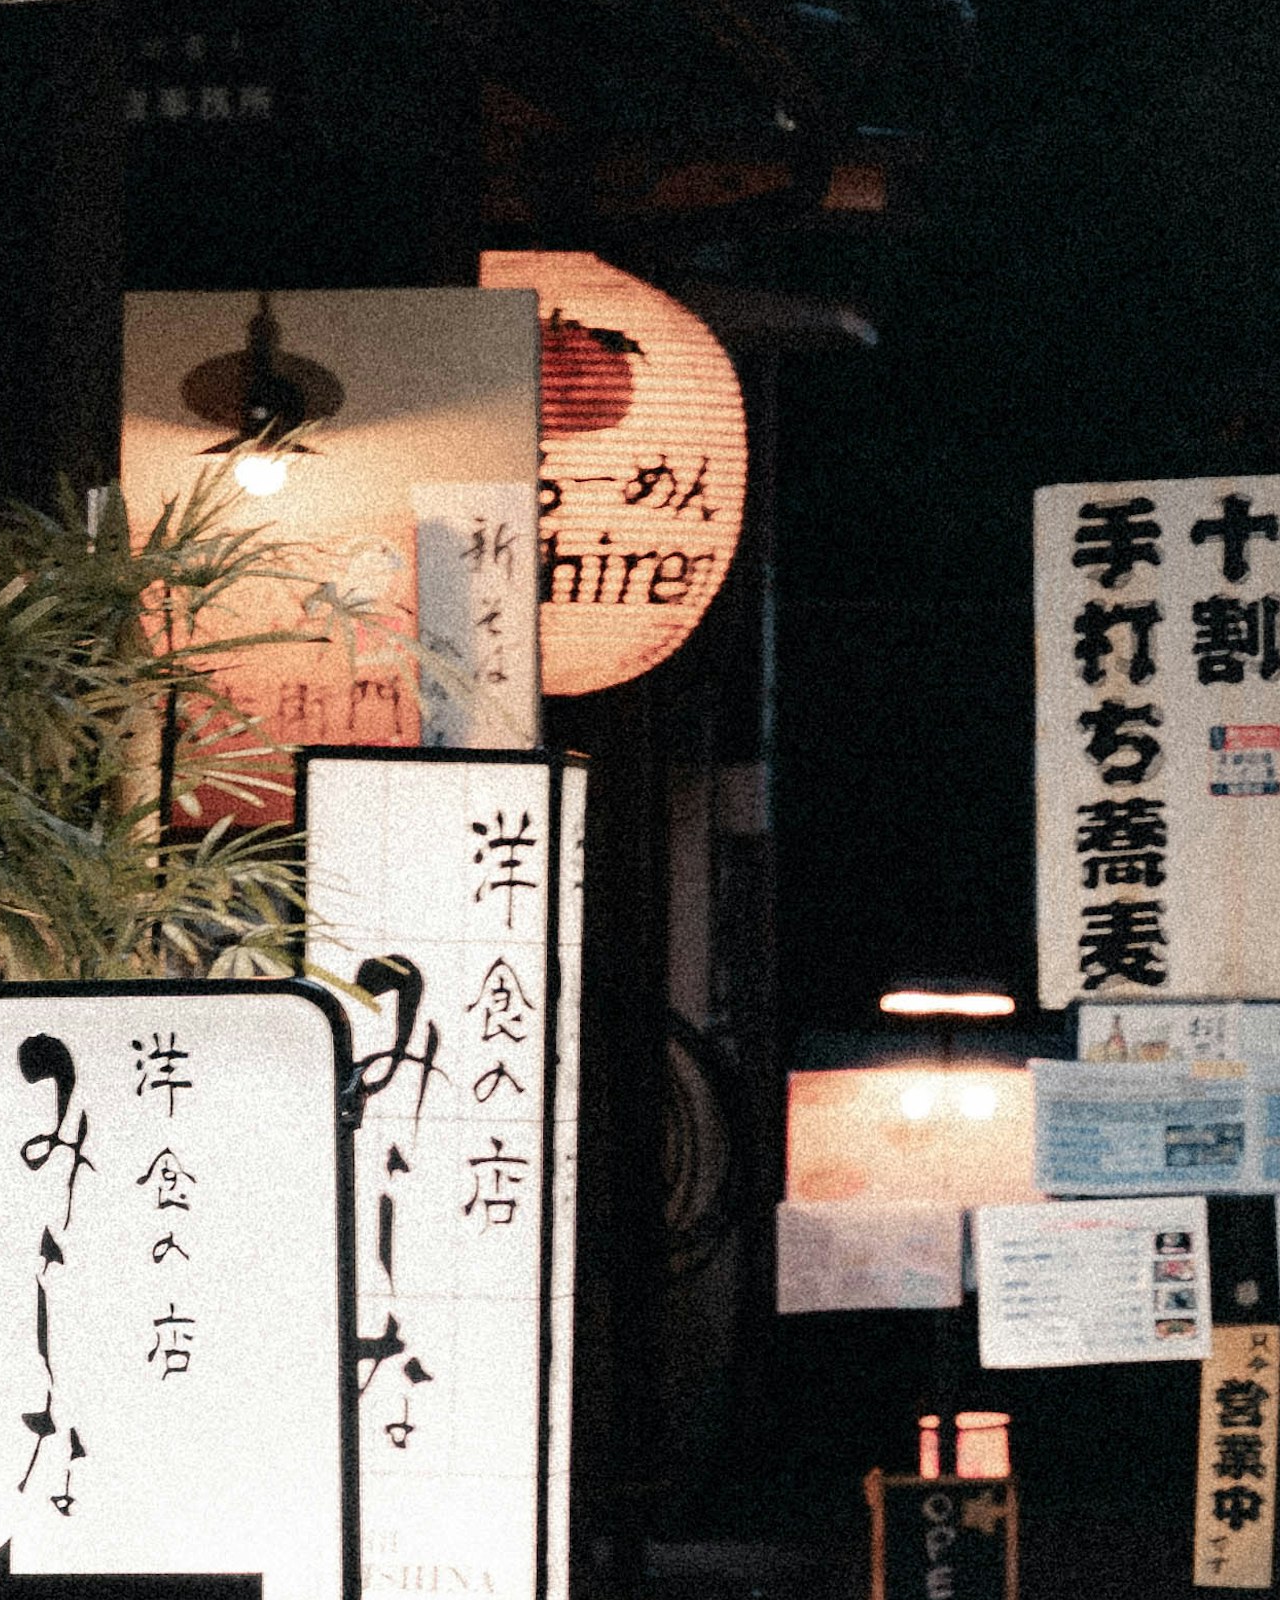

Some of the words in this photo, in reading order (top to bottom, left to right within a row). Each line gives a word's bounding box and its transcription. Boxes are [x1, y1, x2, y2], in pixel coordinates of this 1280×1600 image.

[1072, 497, 1167, 990] 手打ち蕎麦
[129, 1031, 197, 1381] 洋食の店
[463, 811, 538, 1235] 洋食の店
